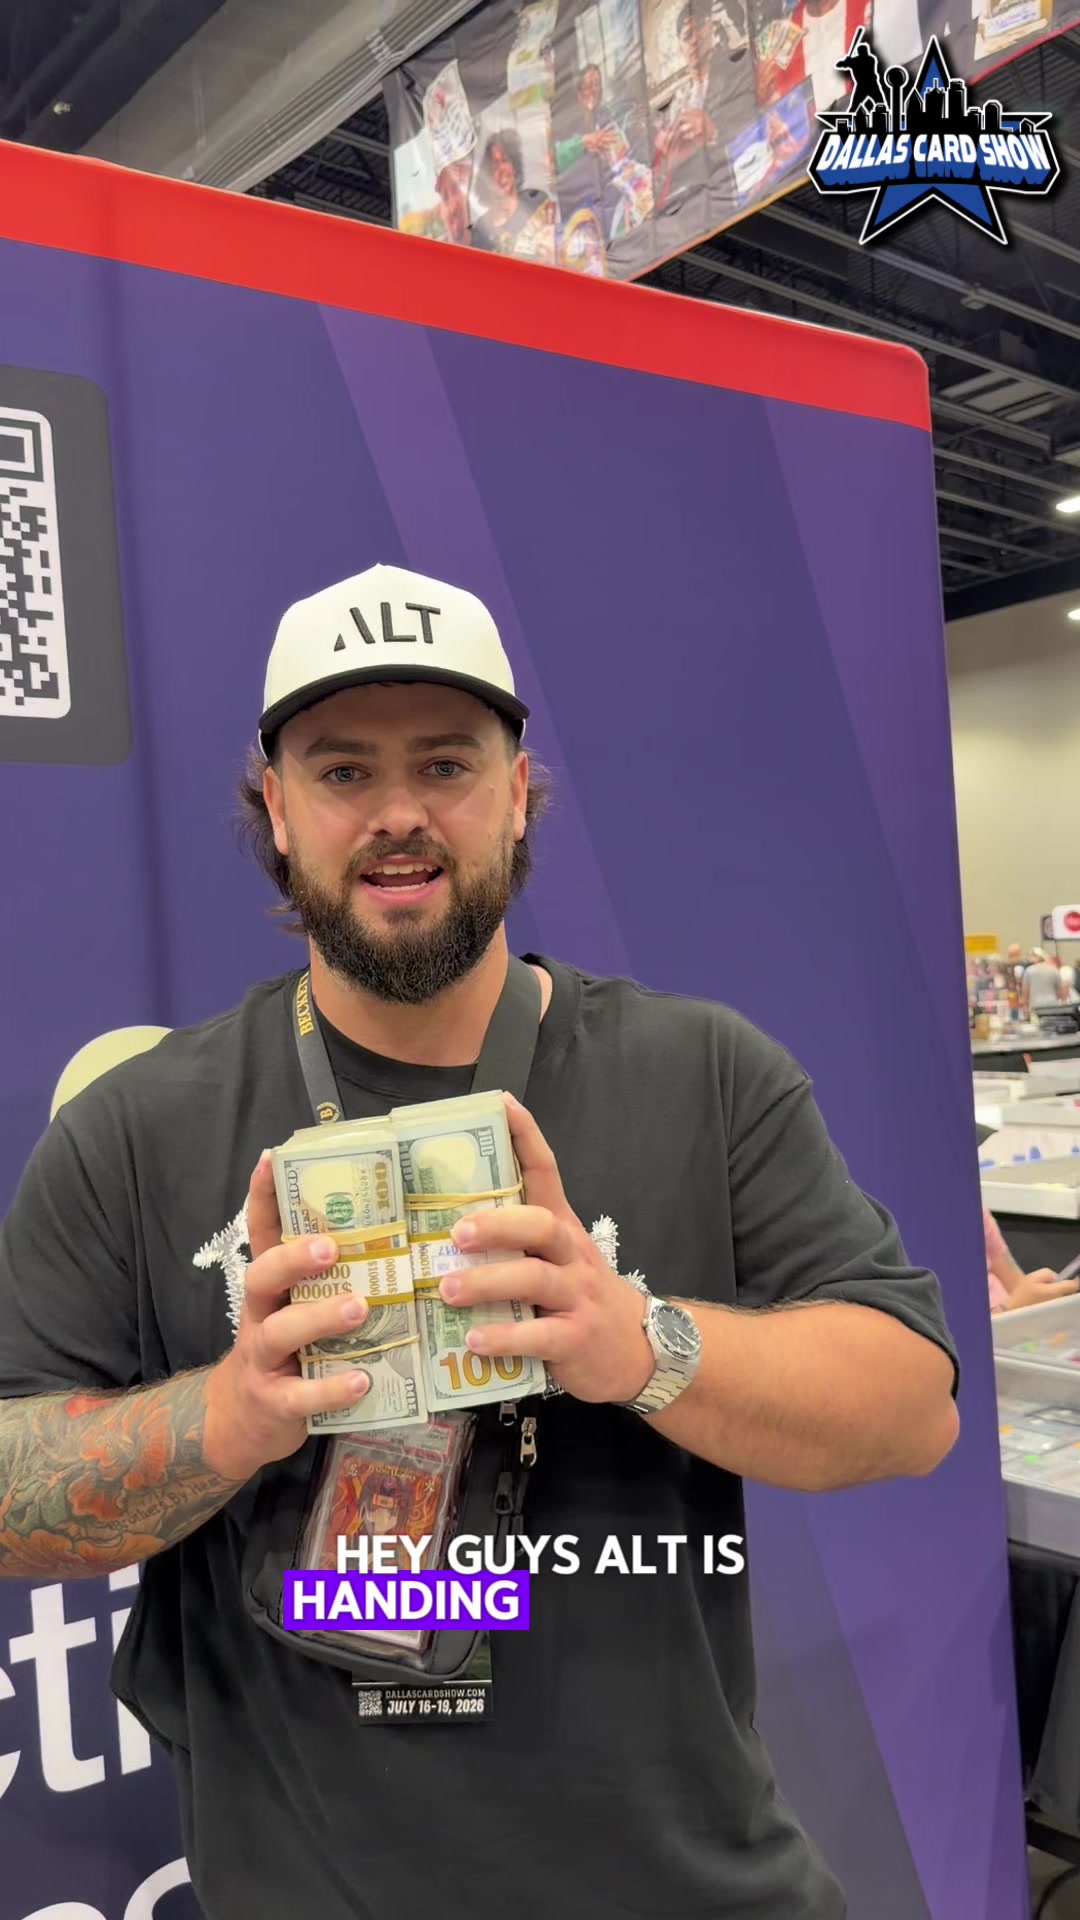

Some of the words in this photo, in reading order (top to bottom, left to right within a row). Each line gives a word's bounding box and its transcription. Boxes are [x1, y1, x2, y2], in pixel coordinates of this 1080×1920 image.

[334, 602, 441, 652] ALT
[291, 1281, 352, 1301] $10000
[367, 1260, 381, 1297] $10000
[384, 1257, 399, 1296] $10000
[439, 1349, 523, 1391] 100
[385, 1688, 486, 1699] DALLASCARDSHOW.COM
[387, 1700, 415, 1715] JULY
[418, 1700, 453, 1716] 16-19,
[455, 1699, 485, 1714] 2026
